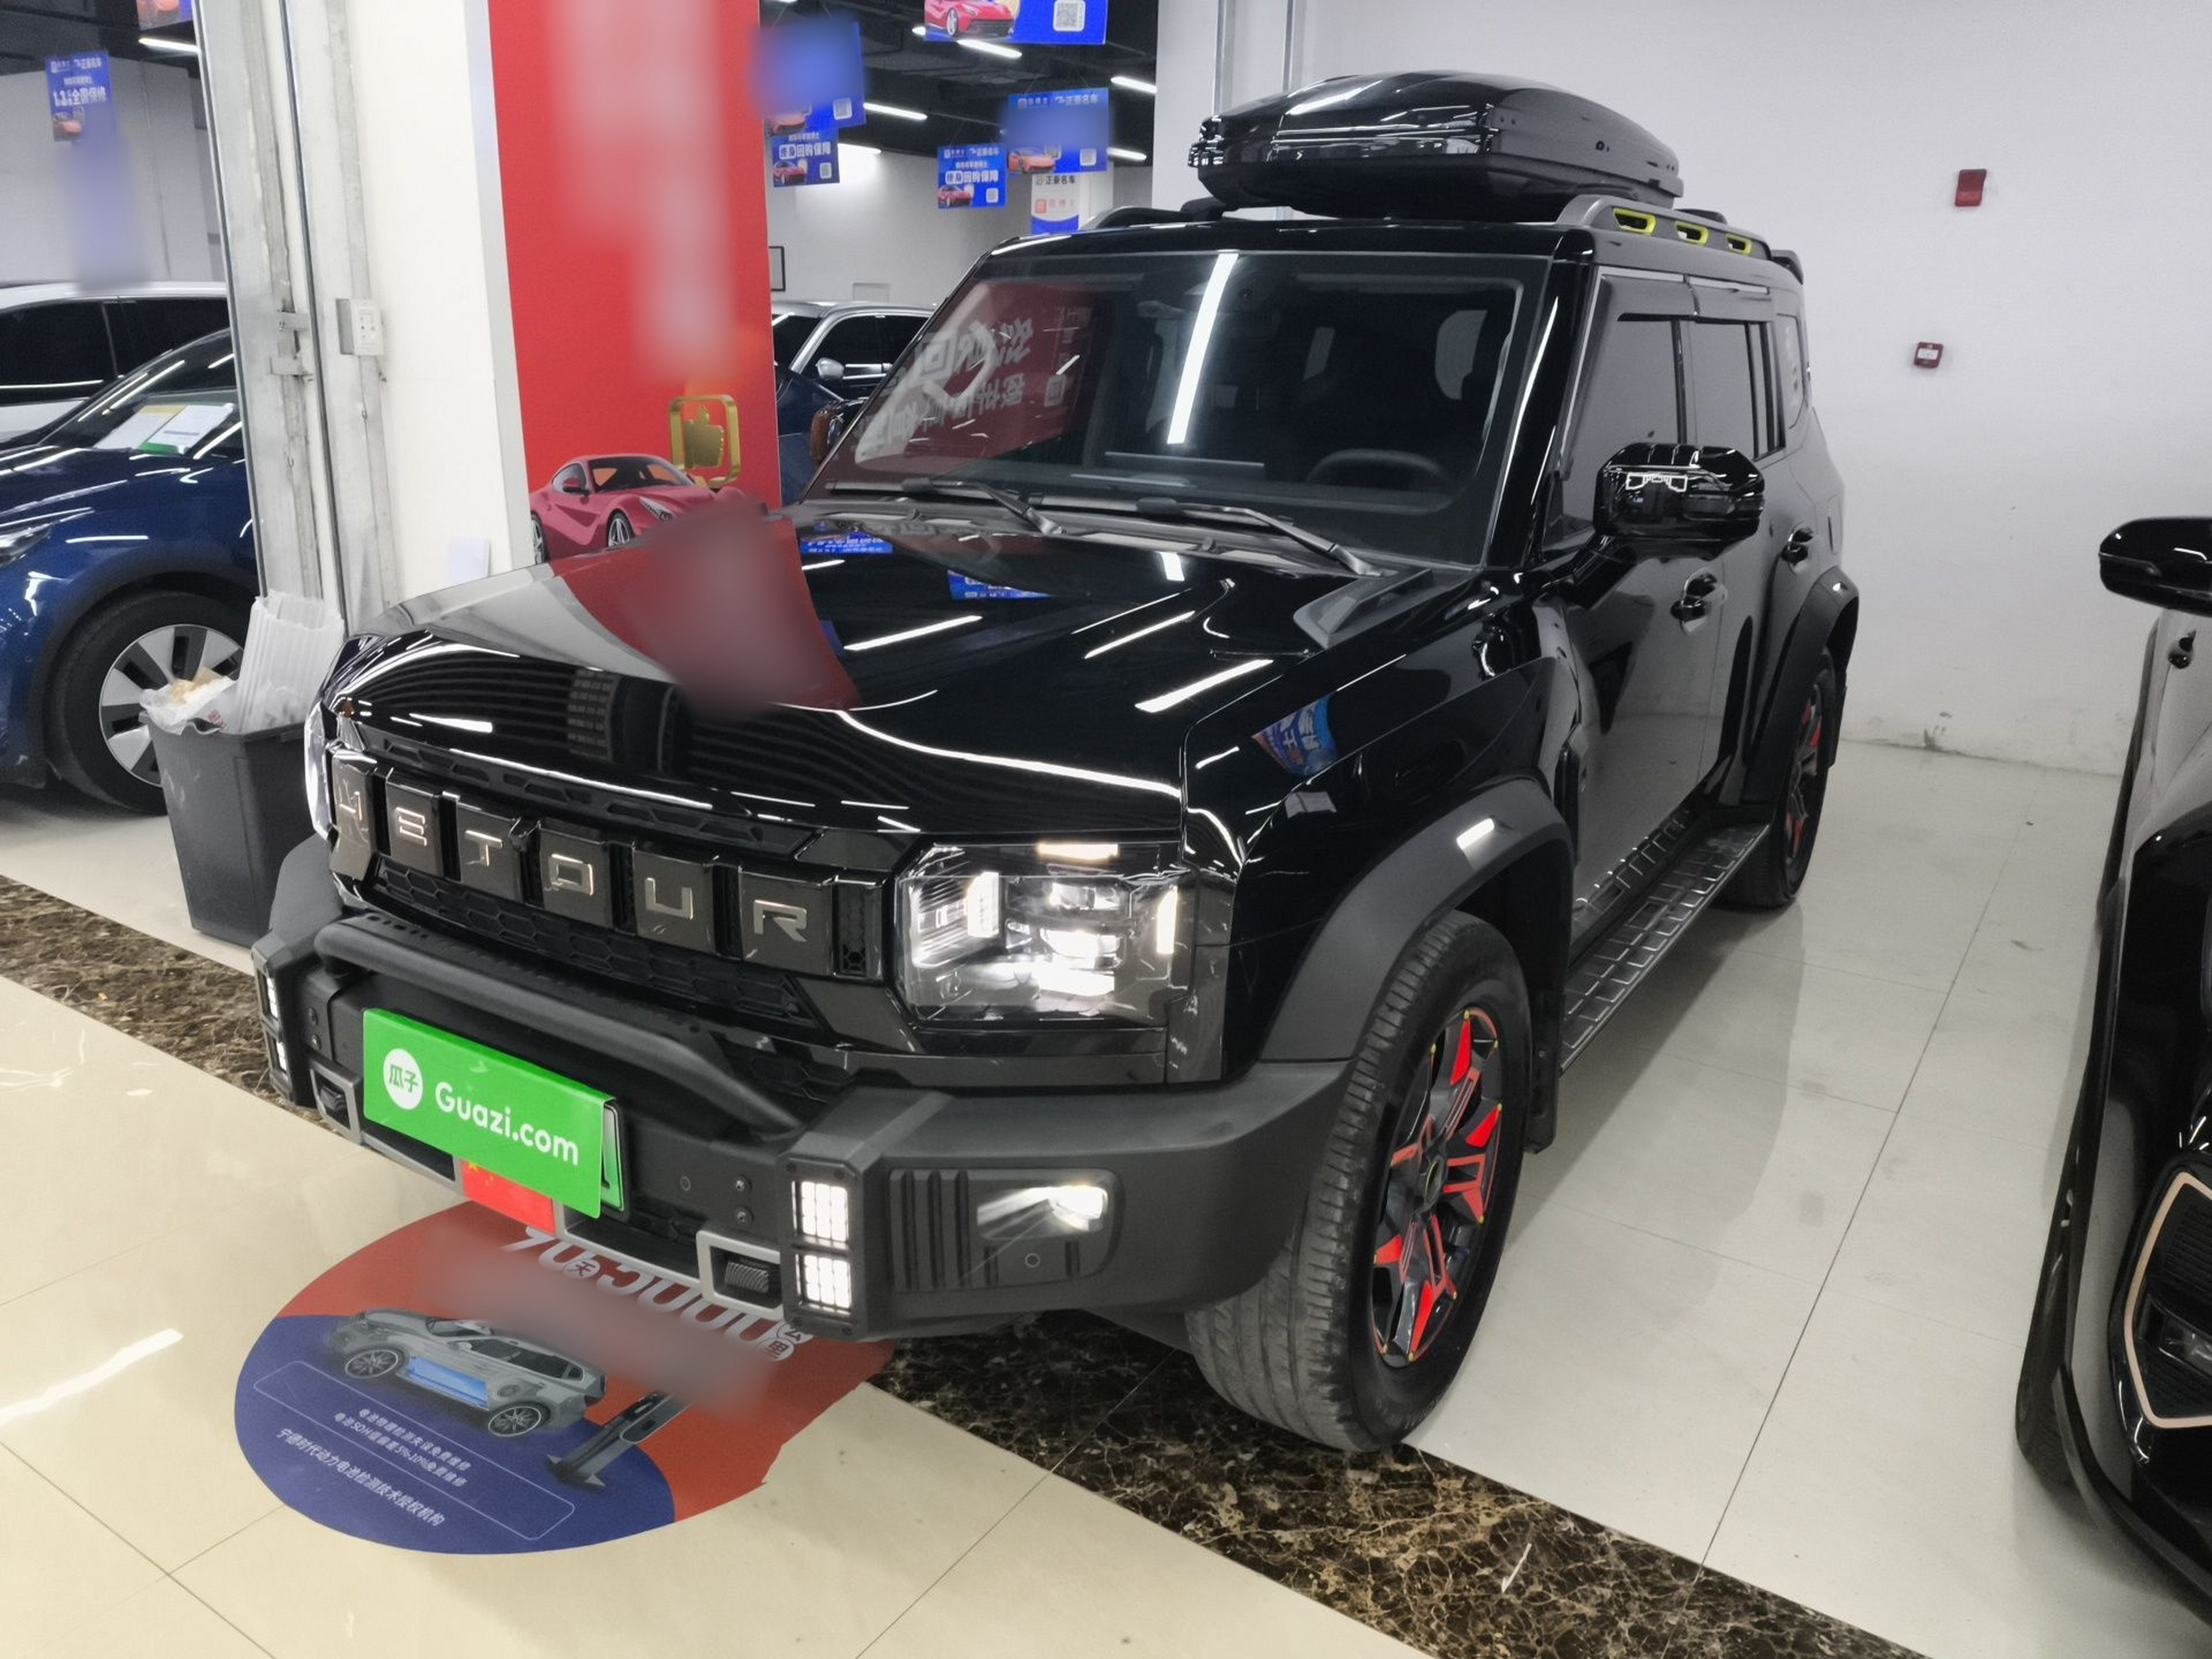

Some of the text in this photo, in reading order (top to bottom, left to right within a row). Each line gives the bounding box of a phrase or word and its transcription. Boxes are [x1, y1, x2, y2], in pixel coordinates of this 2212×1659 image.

[339, 790, 808, 944] JETOUR
[389, 1064, 418, 1093] 瓜子
[435, 1082, 579, 1166] Guazi.com
